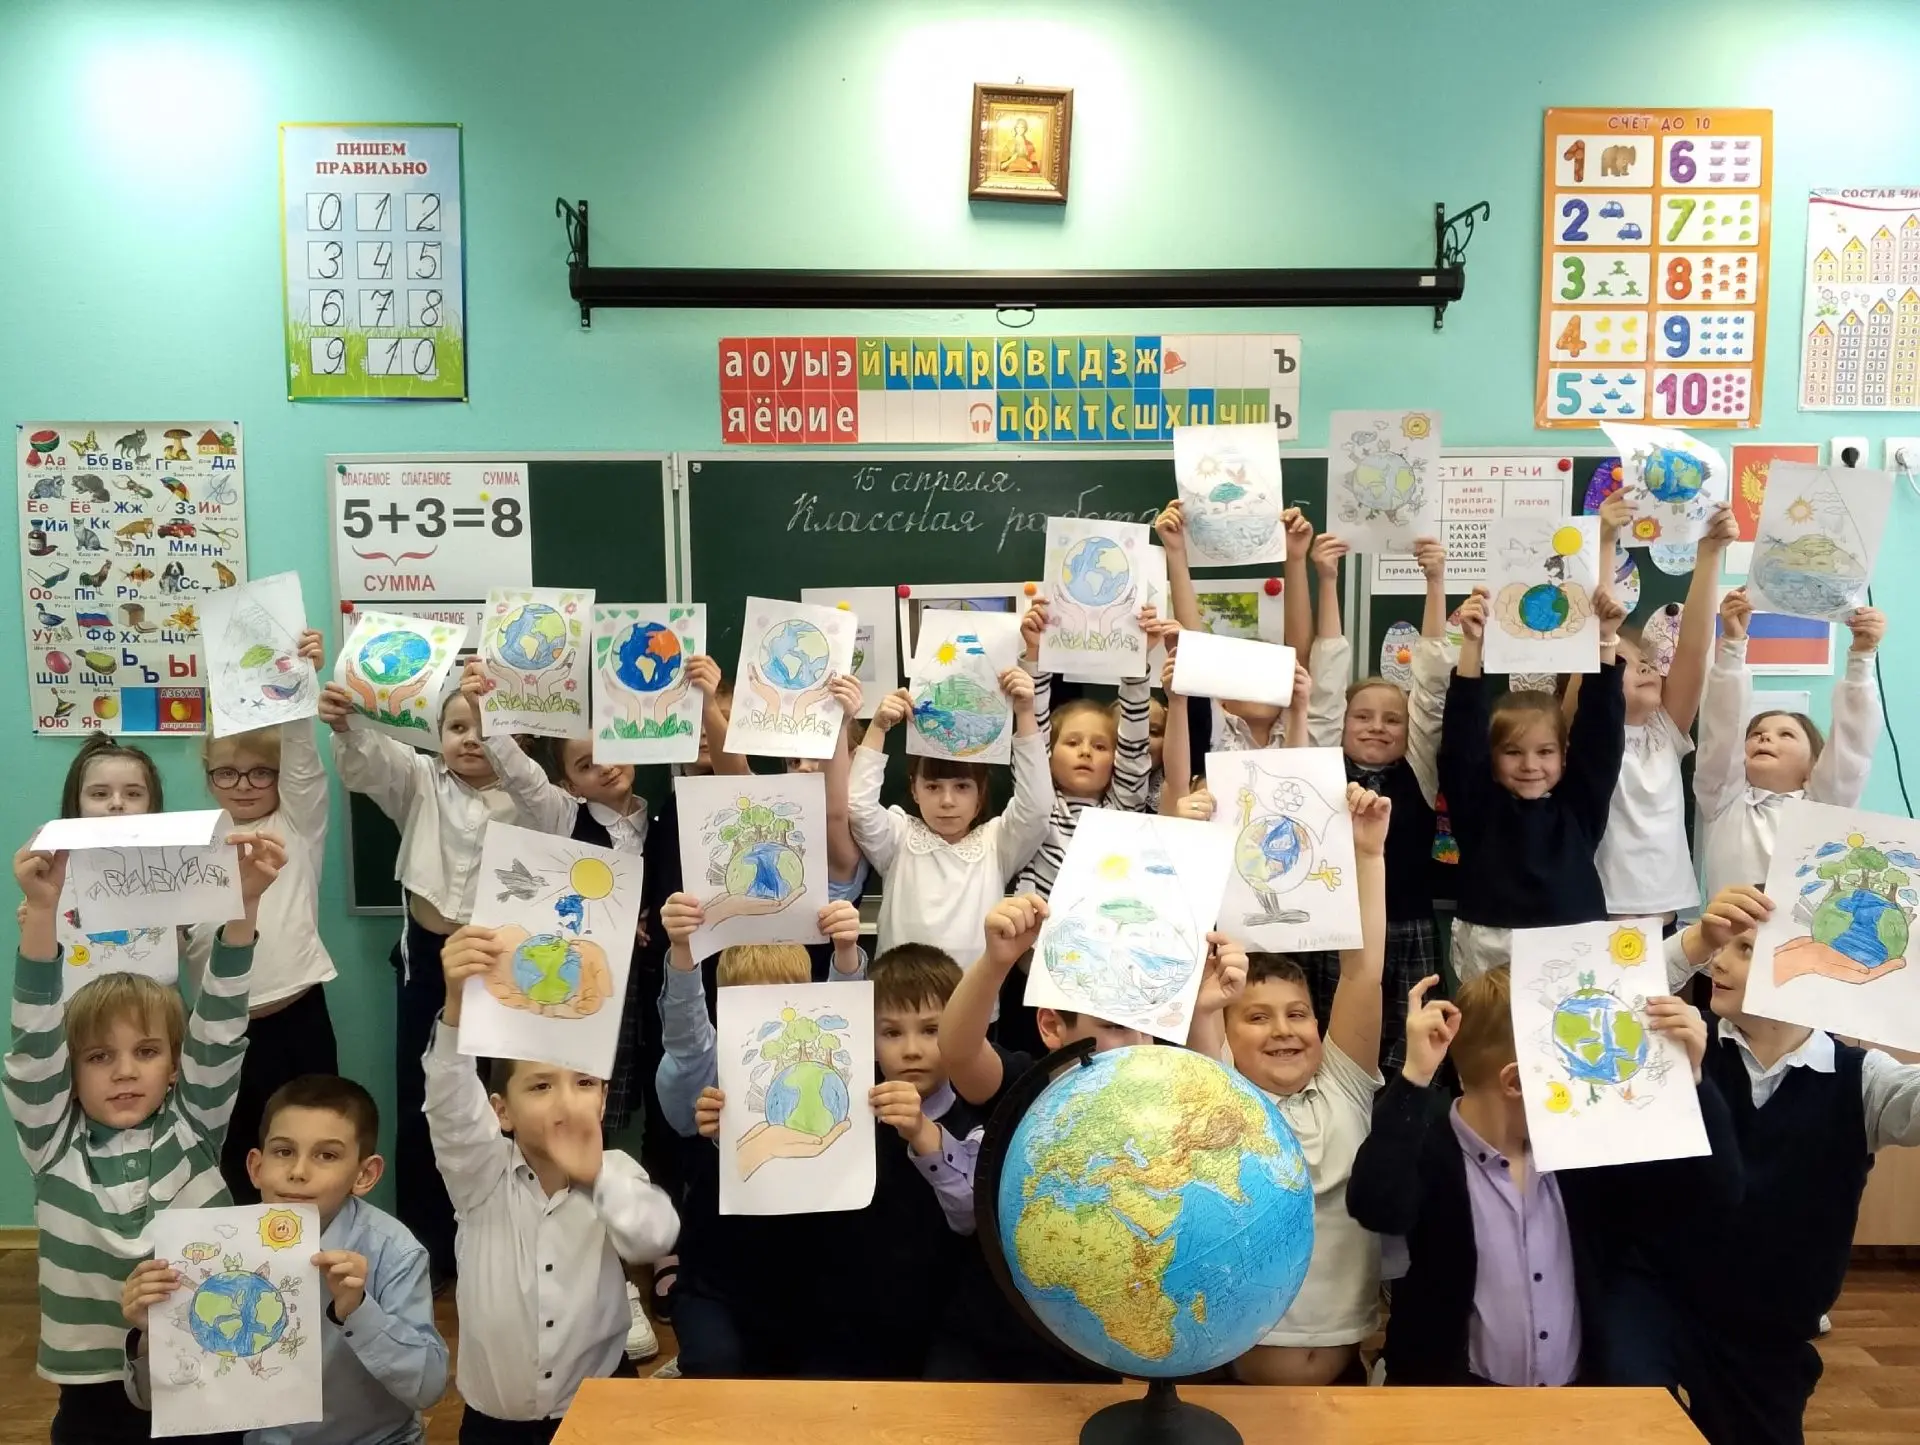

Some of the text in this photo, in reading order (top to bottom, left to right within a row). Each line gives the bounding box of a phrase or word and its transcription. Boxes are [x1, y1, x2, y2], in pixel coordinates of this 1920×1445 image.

[1608, 116, 1711, 131] СЧЕТ ДО 10
[336, 142, 407, 157] ПИШЕМ
[1563, 139, 1586, 183] 1
[1668, 140, 1697, 183] 6
[316, 162, 429, 176] ПРАВИЛЬНО
[1841, 188, 1896, 199] СОСТАВ
[319, 193, 441, 231] 0 1 2
[1562, 198, 1589, 242] 2
[1666, 199, 1697, 242] 7
[318, 241, 442, 279] 3 4 5
[1560, 256, 1586, 300] 3
[1665, 257, 1692, 300] 8
[322, 289, 442, 328] 6 7 8
[1555, 314, 1587, 358] 4
[1664, 315, 1691, 358] 9
[324, 337, 436, 376] 9 10
[725, 351, 743, 377] а
[752, 351, 771, 377] о
[780, 351, 798, 386] у
[804, 351, 828, 376] ы
[836, 351, 852, 377] э
[862, 341, 880, 376] й
[890, 351, 908, 376] н
[914, 351, 938, 376] м
[944, 350, 964, 376] л
[972, 350, 990, 386] р
[1000, 340, 1019, 377] б
[1027, 350, 1046, 376] в
[1058, 350, 1071, 375] г
[1080, 350, 1103, 382] д
[1111, 348, 1128, 374] з
[1135, 348, 1159, 374] ж
[1556, 372, 1582, 416] 5
[1656, 372, 1708, 416] 10
[728, 407, 746, 432] я
[754, 397, 772, 432] ё
[778, 406, 803, 432] ю
[809, 407, 827, 432] и
[836, 406, 854, 432] е
[1000, 406, 1019, 432] п
[1024, 396, 1049, 441] ф
[1054, 405, 1073, 432] к
[1083, 406, 1100, 430] т
[1111, 404, 1126, 430] с
[1134, 404, 1158, 430] ш
[45, 454, 66, 466] Аа
[87, 453, 109, 467] Бб
[112, 458, 133, 471] Вв
[156, 458, 172, 471] Гг
[212, 456, 236, 471] Дд
[342, 472, 521, 486] СЛАГАЕМОЕ СЛАГАЕМОЕ СУММА
[1490, 466, 1542, 477] РЕЧИ
[852, 467, 1021, 512] 15 апреля.
[27, 500, 49, 513] Ее
[70, 498, 92, 514] Ёё
[114, 501, 144, 514] Жж
[175, 502, 196, 515] Зз
[199, 501, 221, 514] Ии
[1514, 498, 1550, 506] глагол
[786, 491, 984, 532] Классная
[45, 517, 69, 532] Йй
[90, 517, 111, 530] Кк
[1449, 522, 1488, 531] КАКОЙ
[134, 544, 155, 557] Лл
[170, 540, 198, 552] Мм
[202, 544, 223, 557] Нн
[180, 577, 200, 590] Сс
[364, 574, 436, 592] СУММА
[30, 587, 53, 600] Оо
[74, 588, 95, 601] Пп
[117, 586, 139, 601] Рр
[32, 629, 53, 644] Уу
[86, 628, 116, 644] Фф
[120, 631, 141, 643] Хх
[161, 630, 186, 644] Цц
[169, 654, 197, 678] Ы
[36, 672, 69, 685] Шш
[80, 672, 114, 687] Щщ
[160, 688, 201, 698] АЗБУКА
[39, 715, 69, 729] Юю
[81, 717, 102, 729] Яя
